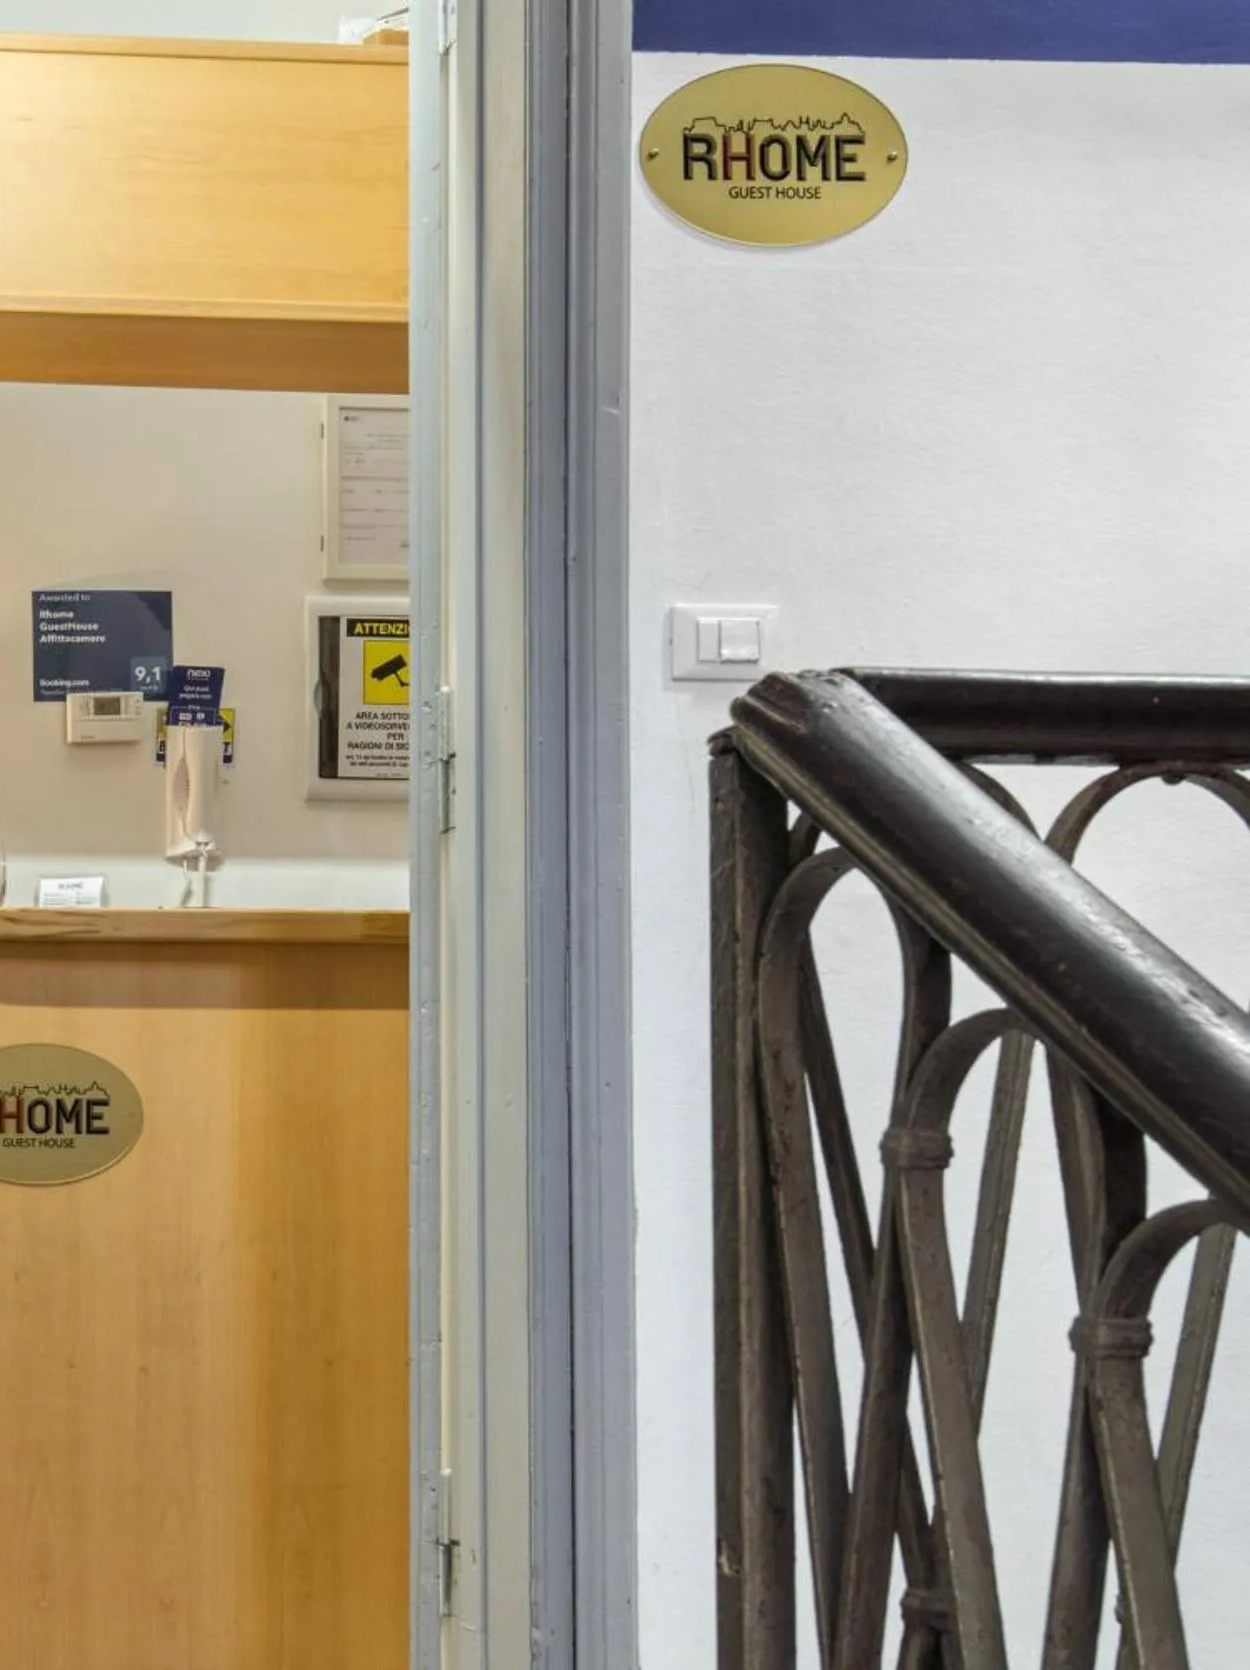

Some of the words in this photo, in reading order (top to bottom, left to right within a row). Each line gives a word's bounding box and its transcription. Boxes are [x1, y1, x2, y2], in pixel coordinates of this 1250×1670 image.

[682, 132, 867, 182] RHOME
[728, 185, 773, 200] GUEST
[775, 185, 823, 200] HOUSE
[39, 609, 75, 619] Rhome
[353, 621, 410, 635] ATTENZI
[134, 666, 162, 683] 9,1
[355, 711, 379, 720] AREA
[380, 712, 410, 721] SOTTO
[346, 721, 353, 730] A
[354, 722, 411, 731] VIDEOSORVE
[386, 732, 405, 741] PER
[347, 741, 383, 750] RAGIONI
[384, 742, 394, 751] DI
[2, 1137, 37, 1148] GUEST
[38, 1137, 76, 1149] HOUSE
